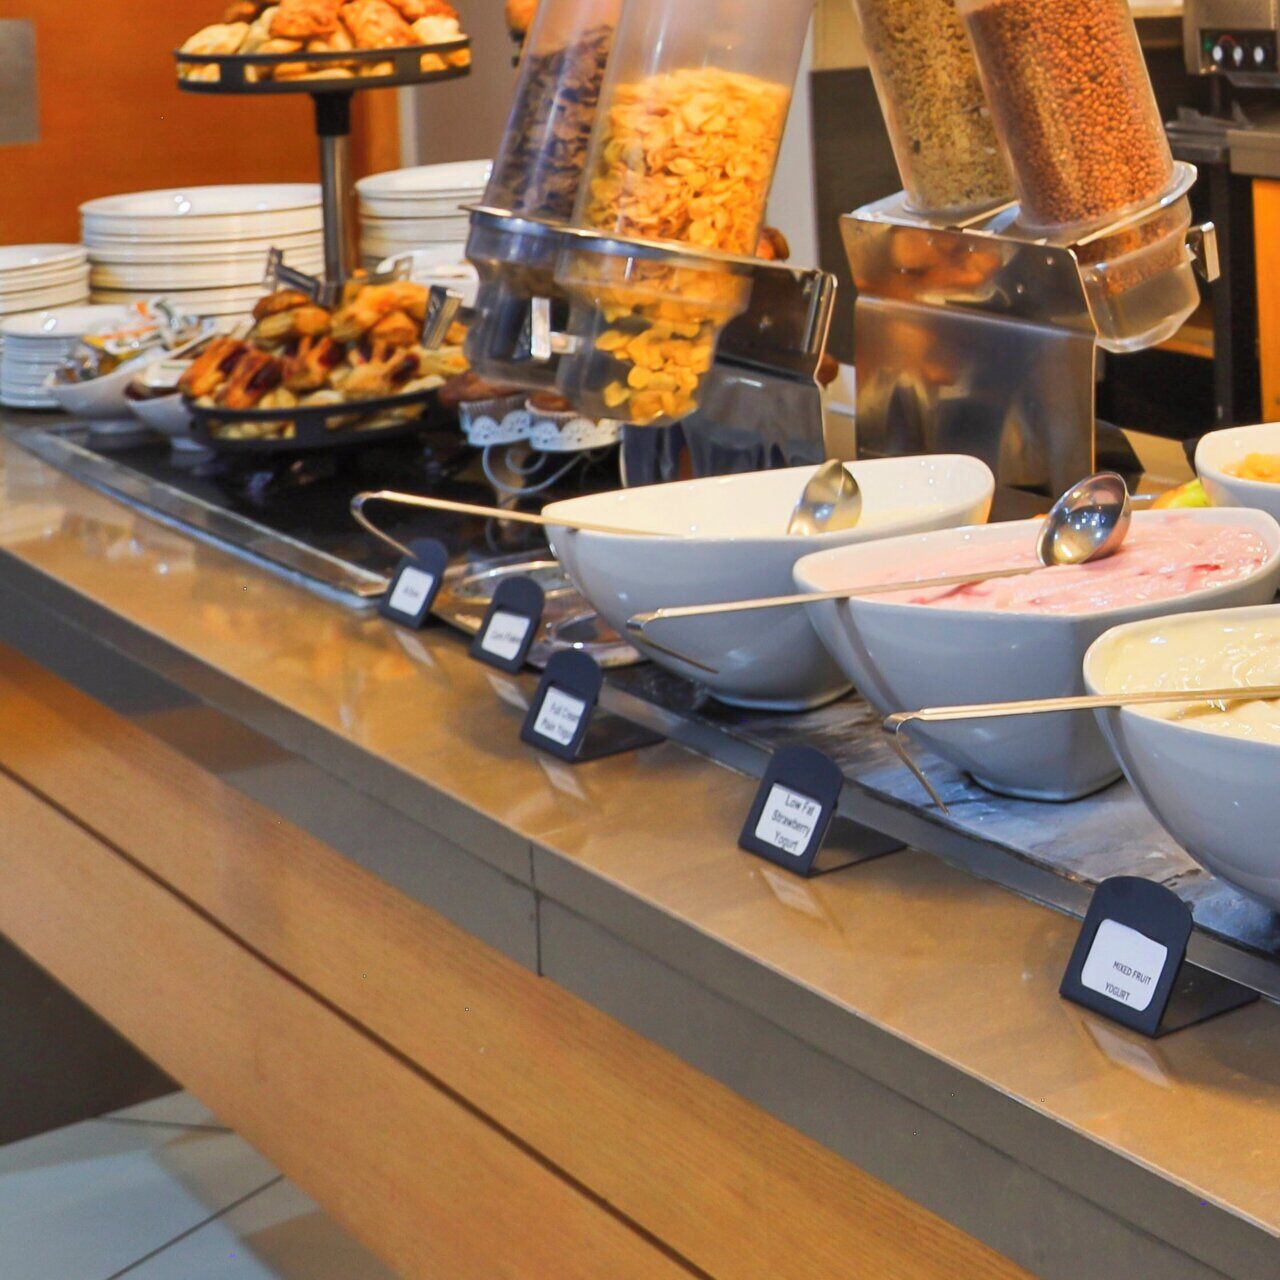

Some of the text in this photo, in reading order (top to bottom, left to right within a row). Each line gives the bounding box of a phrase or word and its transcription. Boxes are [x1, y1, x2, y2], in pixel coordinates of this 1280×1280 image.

[785, 794, 815, 816] Low Fat
[771, 809, 811, 838] Strawberry
[1112, 960, 1151, 985] MIXED FRUIT
[1105, 982, 1130, 1001] YOGURT
